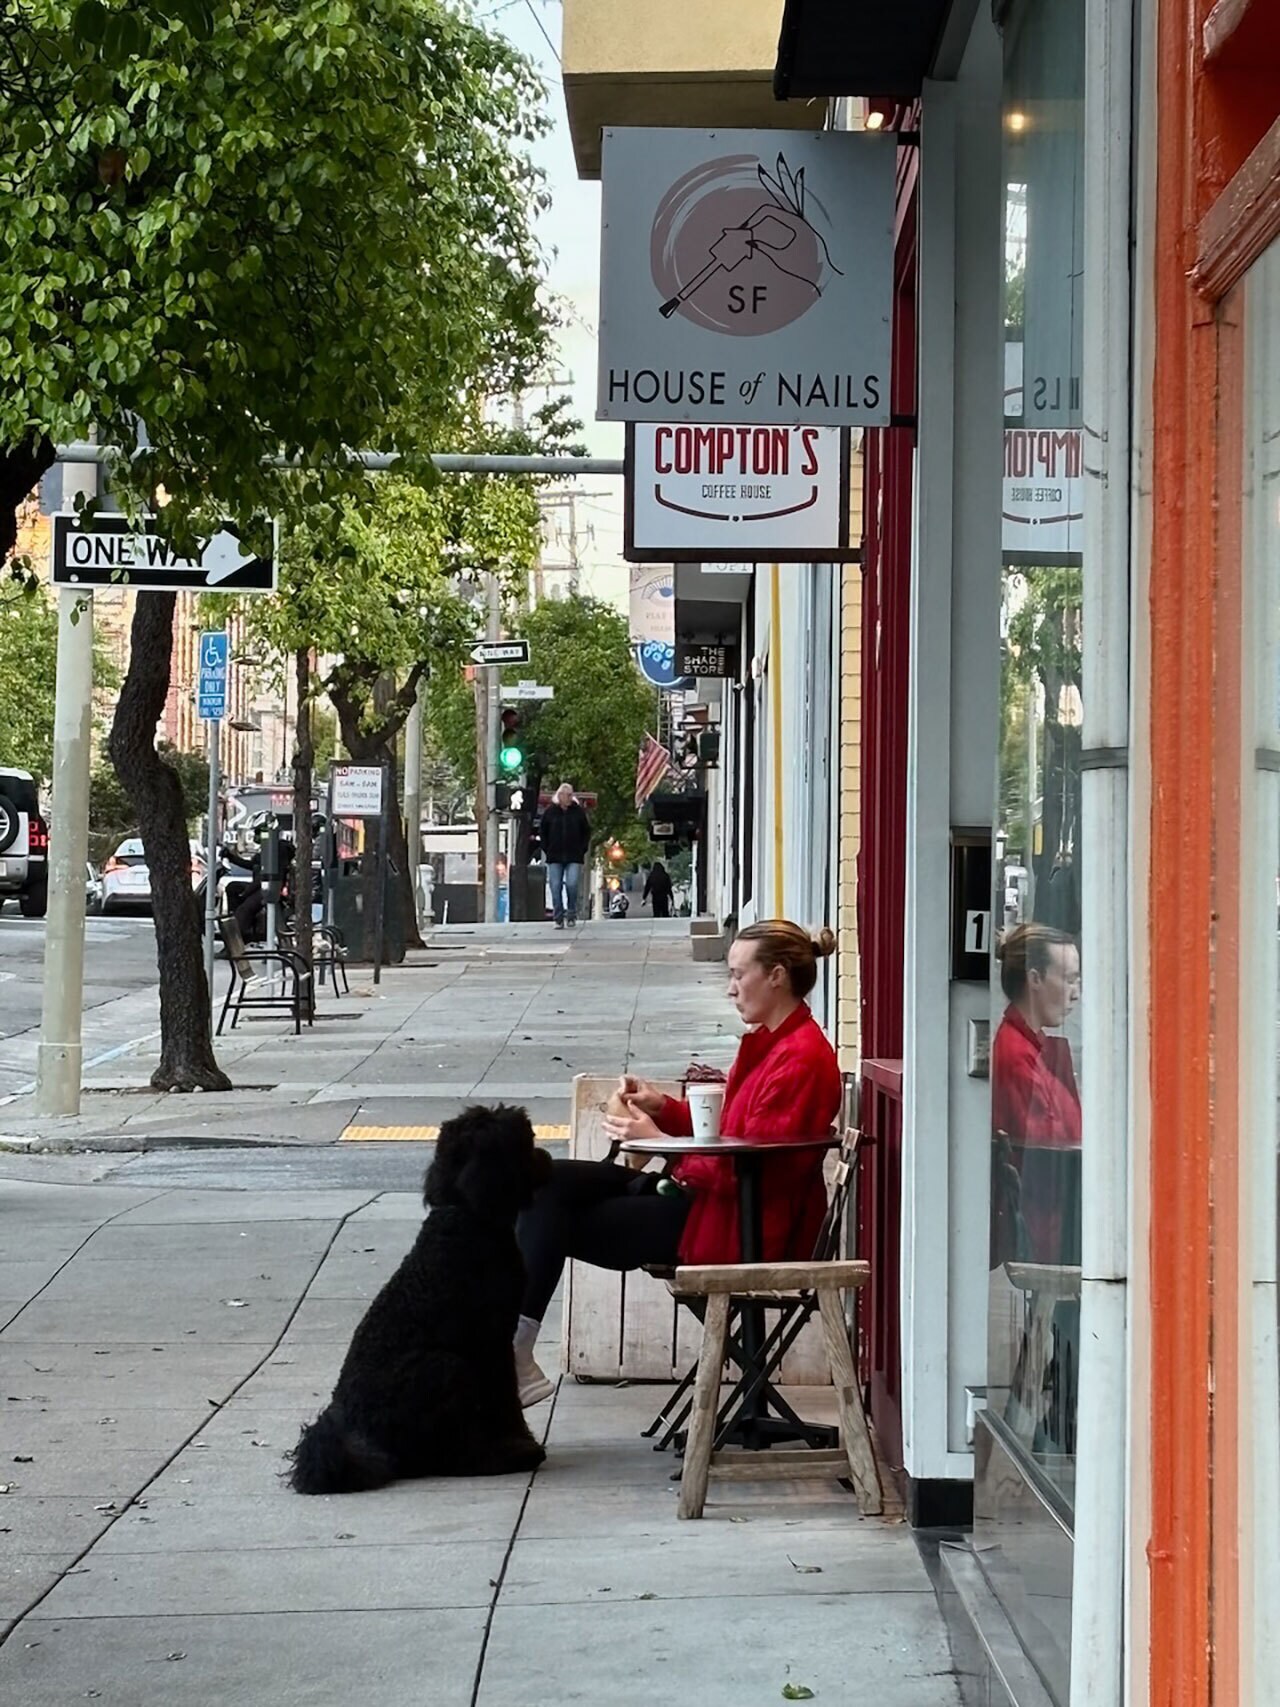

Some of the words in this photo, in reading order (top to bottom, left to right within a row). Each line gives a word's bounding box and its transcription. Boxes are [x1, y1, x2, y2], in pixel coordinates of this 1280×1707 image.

[727, 285, 768, 314] SF
[608, 369, 726, 405] HOUSE
[739, 372, 766, 405] of
[777, 373, 880, 409] NAILS
[655, 424, 819, 476] COMPTON'S
[701, 484, 737, 499] COFFEE
[740, 485, 772, 499] HOUSE
[72, 535, 136, 565] ONE
[684, 656, 725, 665] SHADE
[701, 646, 725, 655] THE
[684, 665, 725, 674] STORE
[336, 767, 348, 776] NO
[972, 913, 984, 950] 1
